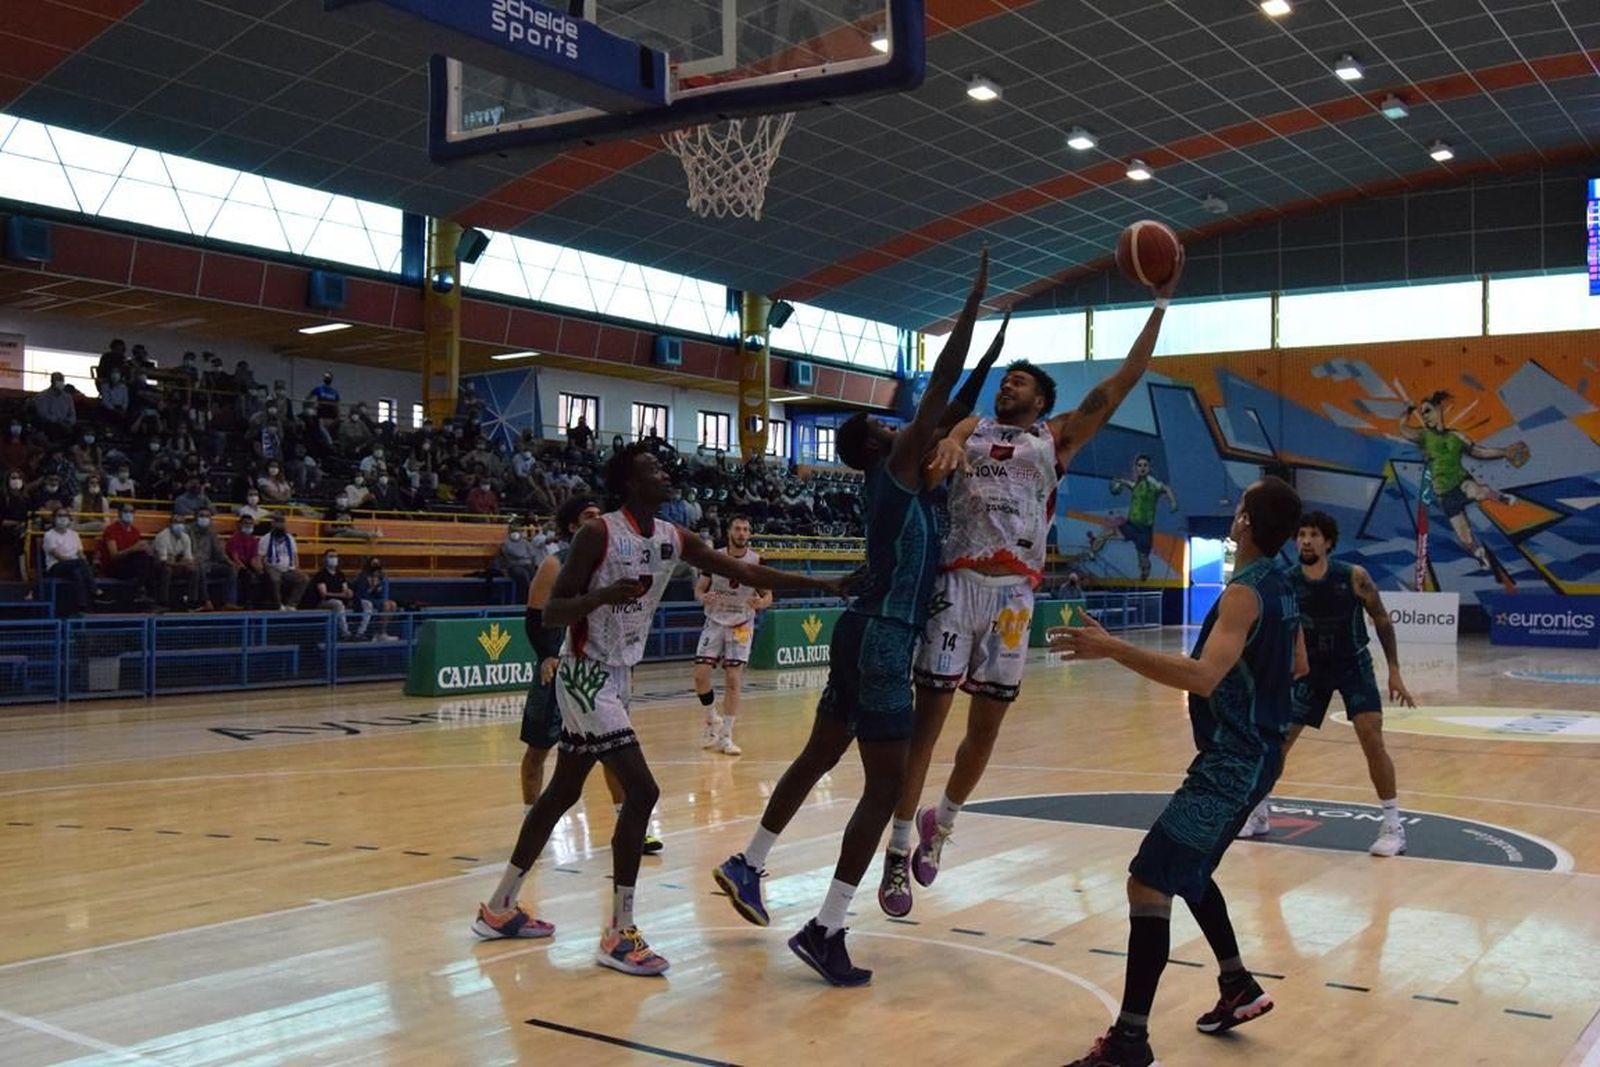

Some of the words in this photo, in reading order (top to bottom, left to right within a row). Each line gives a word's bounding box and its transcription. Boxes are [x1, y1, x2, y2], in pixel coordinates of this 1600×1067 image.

[491, 10, 578, 59] Sports
[1390, 609, 1456, 626] Oblanca
[1508, 610, 1596, 629] euronics
[942, 631, 958, 652] 14
[776, 647, 805, 664] CAJA
[806, 644, 831, 662] RUR
[437, 665, 484, 689] CAJA
[485, 660, 536, 686] RURA
